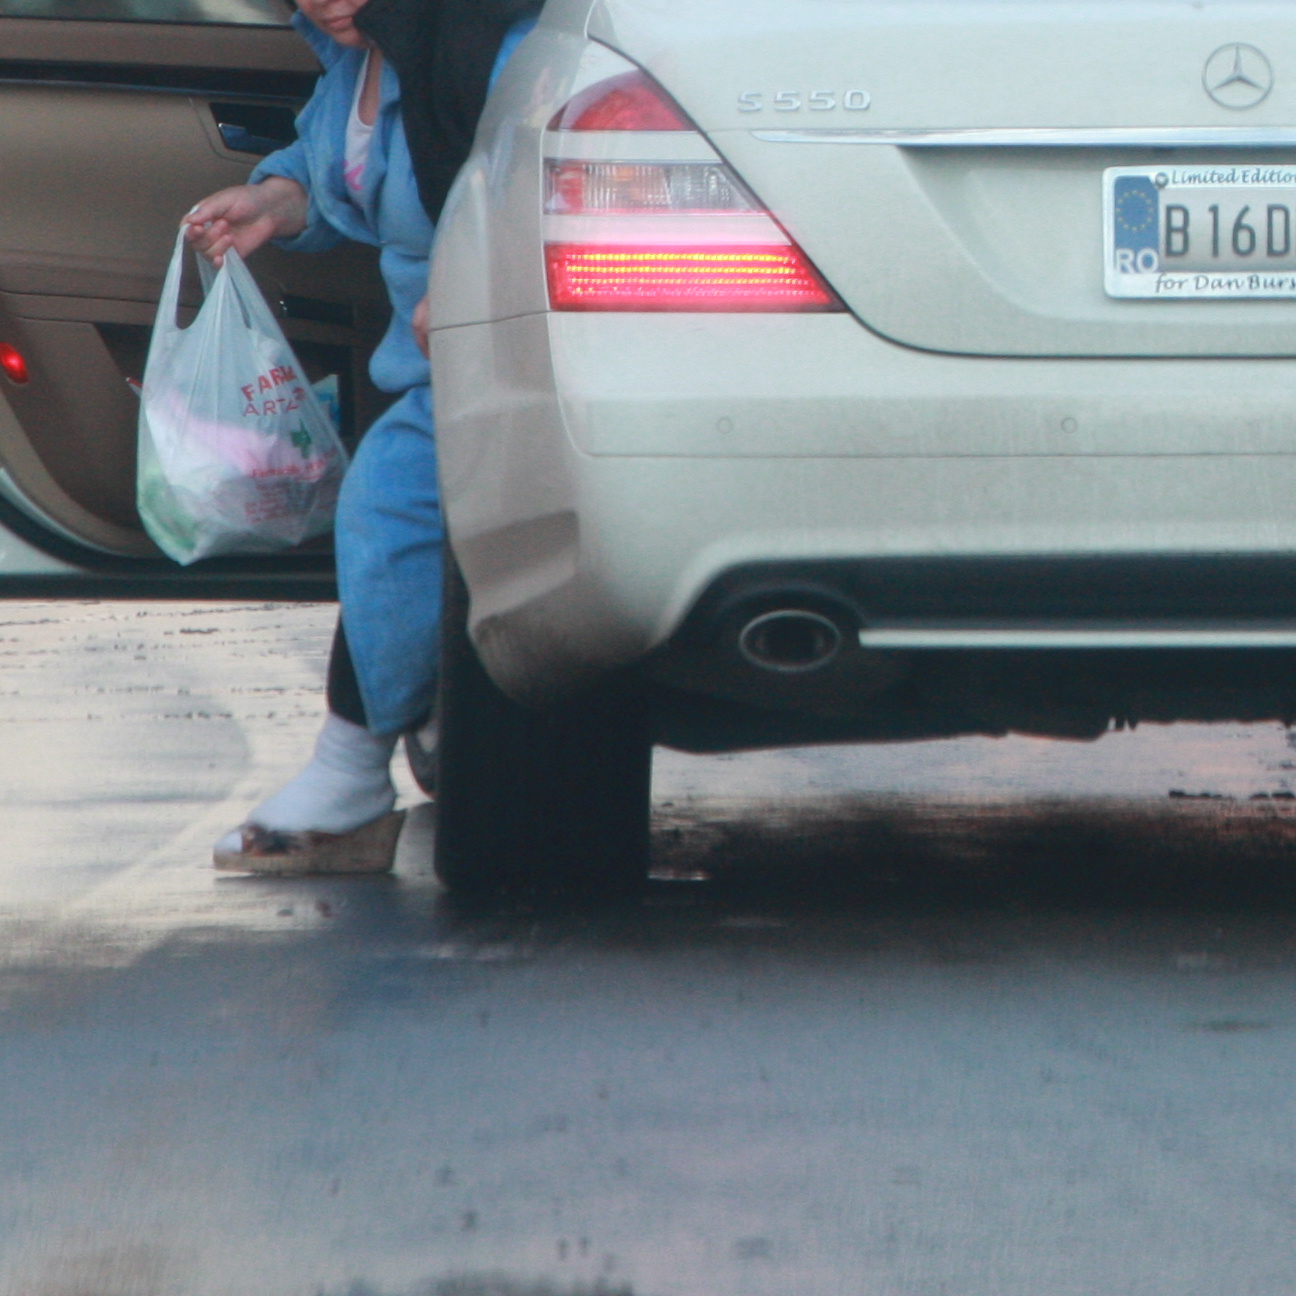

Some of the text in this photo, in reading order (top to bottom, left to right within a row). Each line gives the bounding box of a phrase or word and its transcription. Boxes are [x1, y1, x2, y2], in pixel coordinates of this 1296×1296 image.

[1171, 168, 1240, 184] Limited
[1115, 248, 1158, 273] RO
[1155, 273, 1188, 293] for
[1194, 274, 1244, 290] Dan
